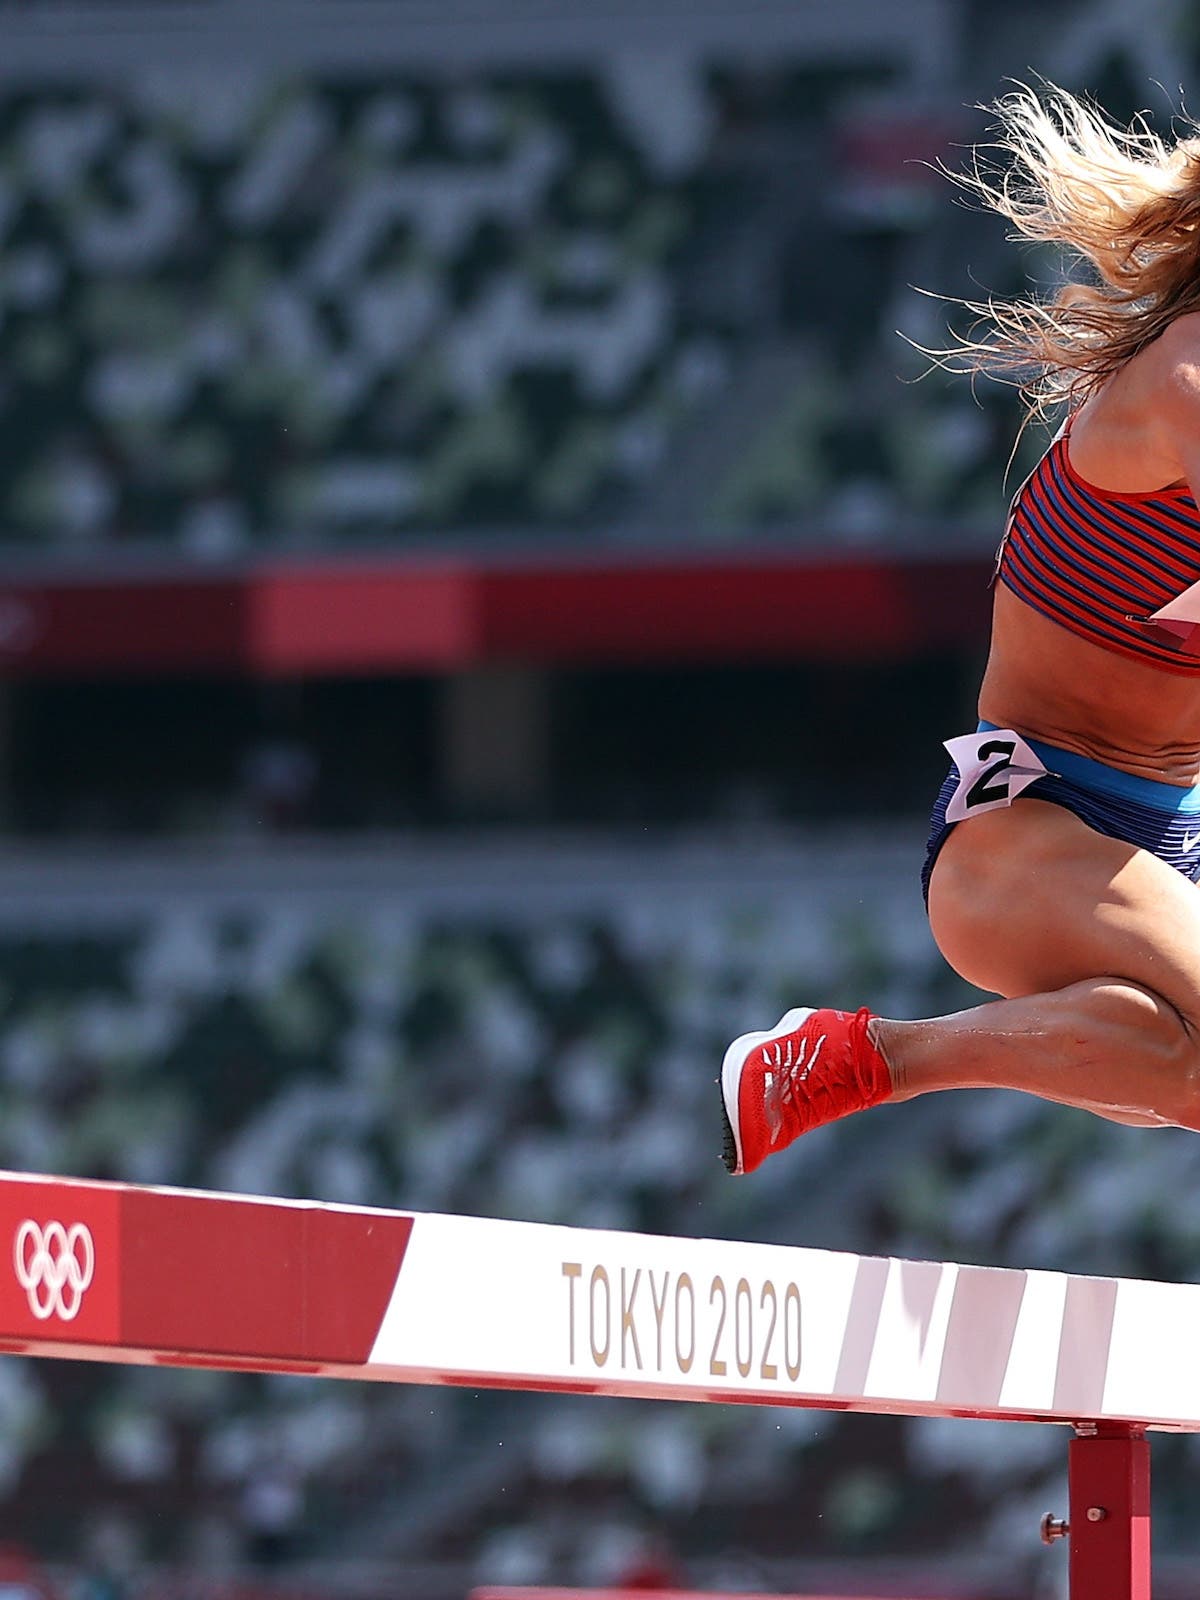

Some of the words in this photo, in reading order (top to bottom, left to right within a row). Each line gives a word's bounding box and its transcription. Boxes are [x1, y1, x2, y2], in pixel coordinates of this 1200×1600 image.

[966, 740, 1016, 809] 2
[562, 1262, 695, 1373] TOKYO
[709, 1275, 801, 1382] 2020
